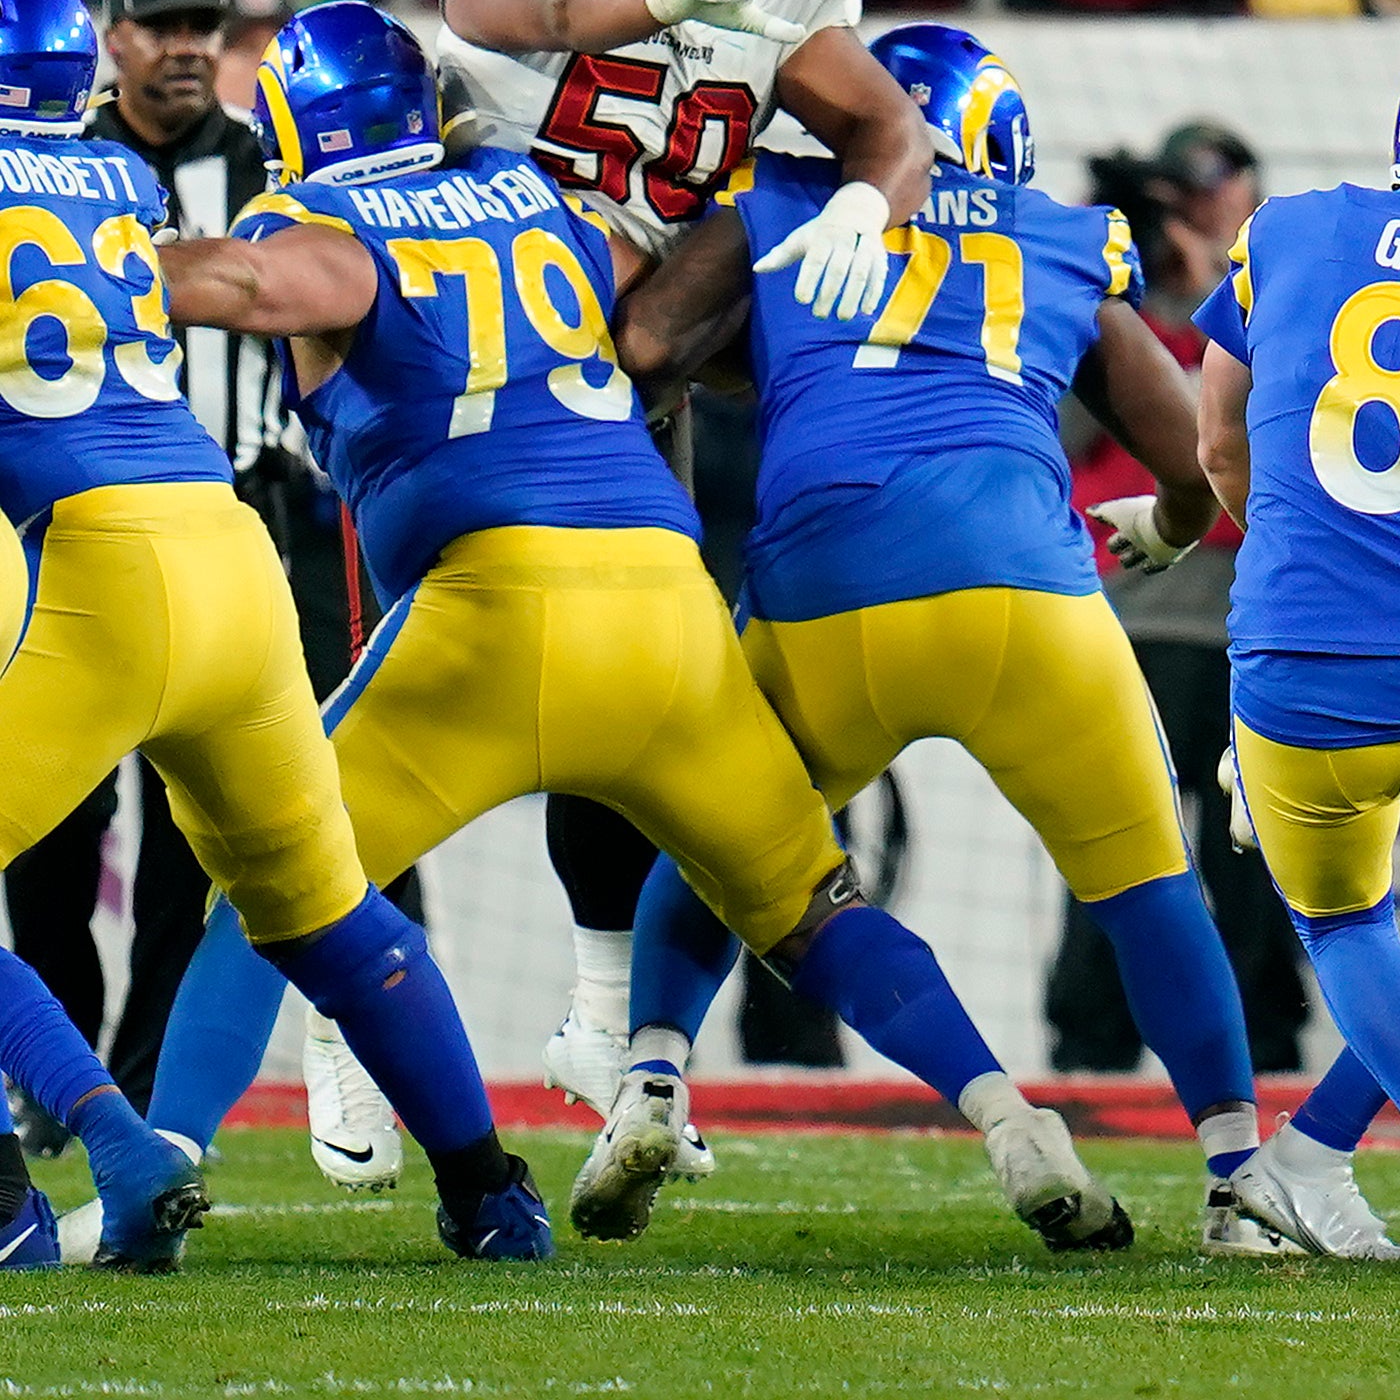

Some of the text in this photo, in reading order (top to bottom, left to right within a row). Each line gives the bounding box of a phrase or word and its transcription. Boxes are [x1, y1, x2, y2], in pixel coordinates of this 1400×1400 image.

[0, 148, 138, 202] ORBETT
[331, 152, 435, 184] LOS ANGELES
[529, 50, 759, 225] 50
[909, 187, 998, 226] ANS
[0, 204, 185, 419] 63
[385, 226, 634, 440] 79
[852, 231, 1025, 387] 71
